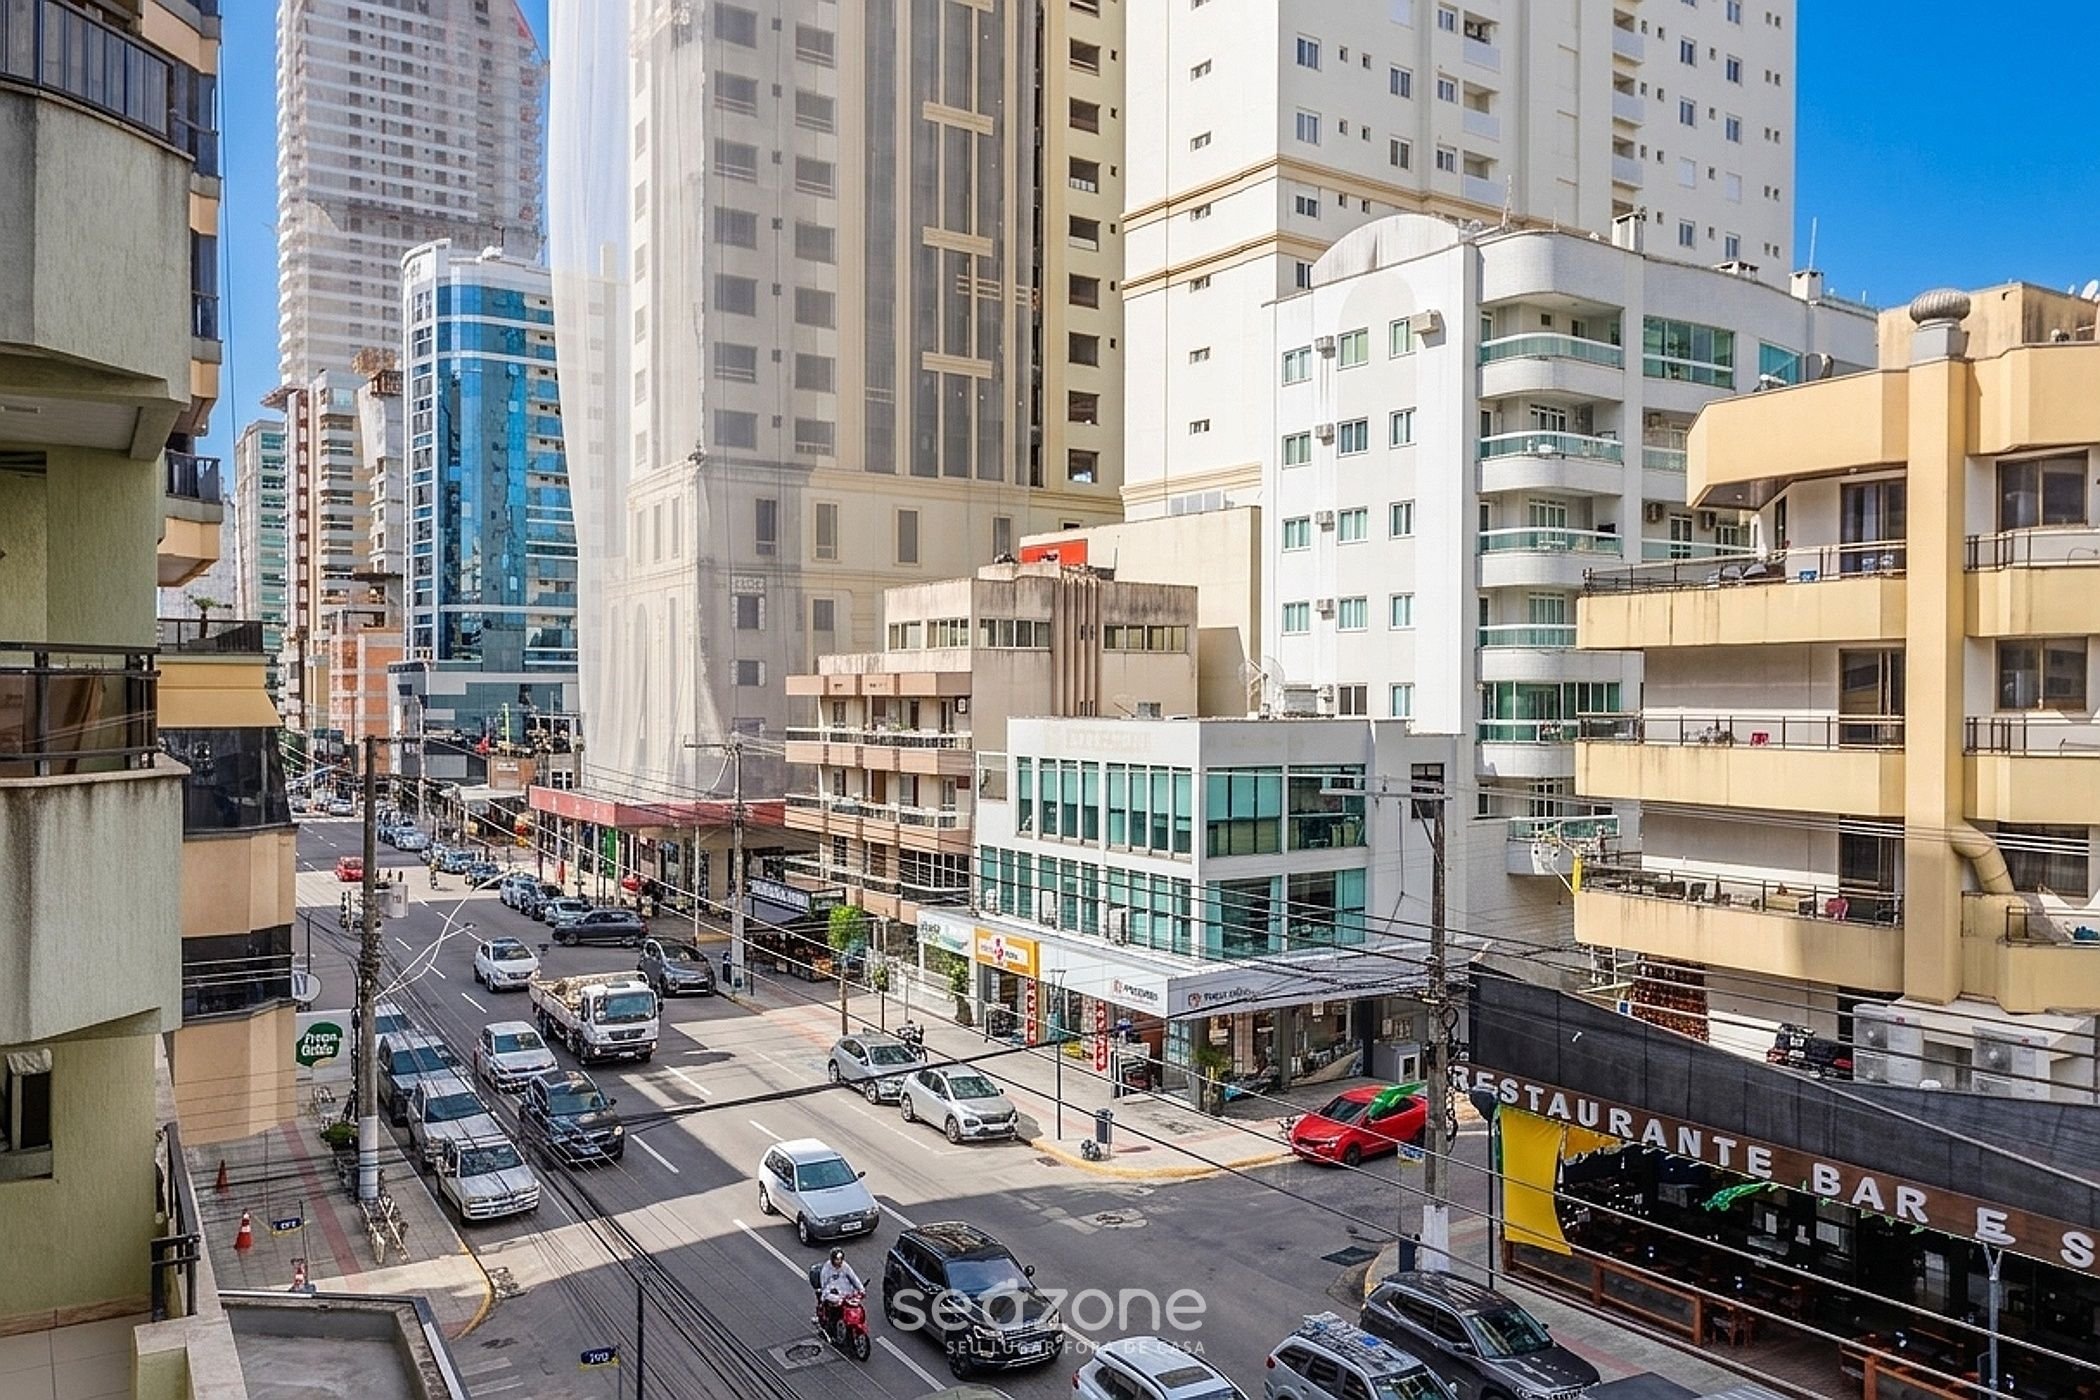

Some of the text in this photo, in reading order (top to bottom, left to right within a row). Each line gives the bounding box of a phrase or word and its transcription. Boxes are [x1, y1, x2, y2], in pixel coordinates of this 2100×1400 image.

[1449, 1065, 2096, 1268] RESTAURANTE BAR E S
